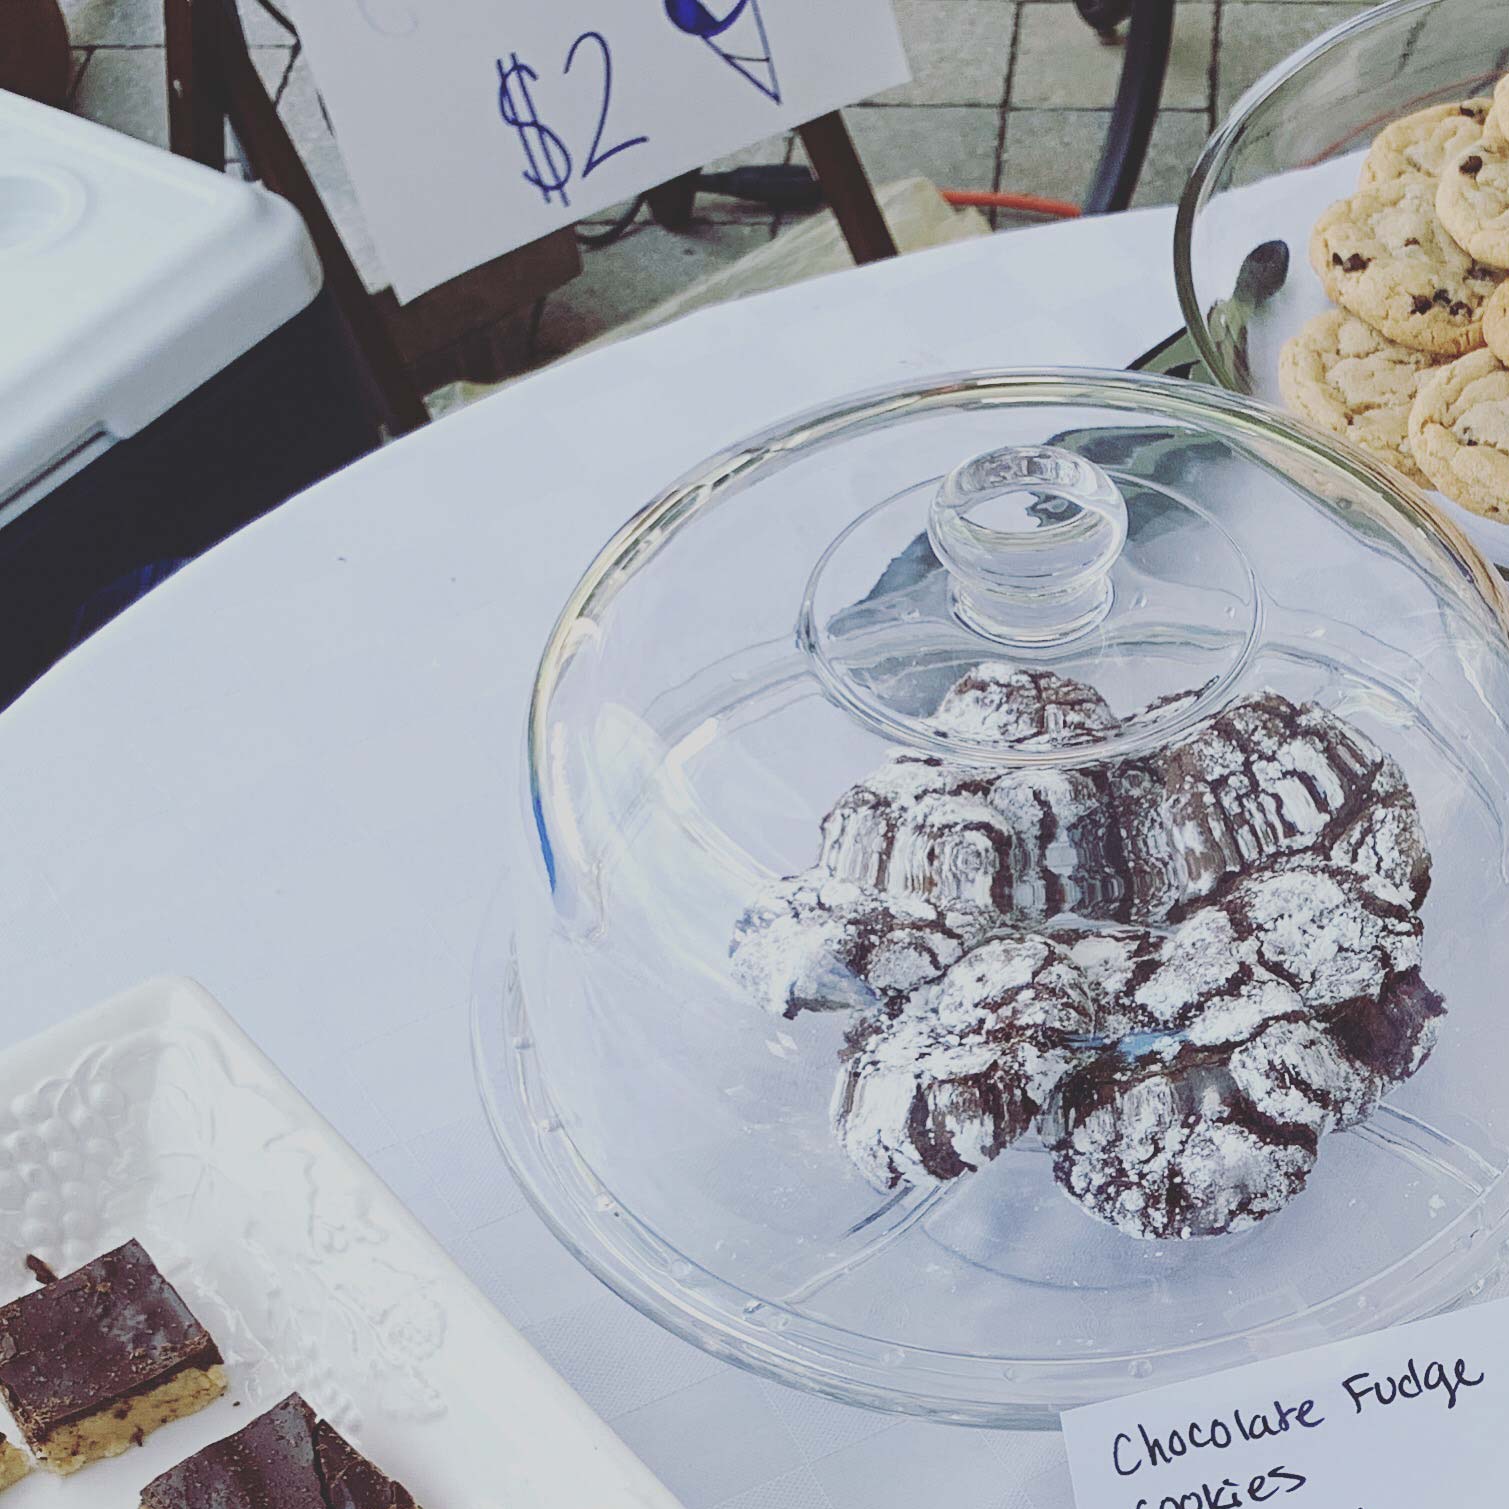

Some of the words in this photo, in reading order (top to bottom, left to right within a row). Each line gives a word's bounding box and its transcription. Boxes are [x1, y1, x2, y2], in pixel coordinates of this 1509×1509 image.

[497, 32, 650, 206] $2
[1112, 1398, 1327, 1476] Chocolate
[1342, 1358, 1485, 1414] Fudge
